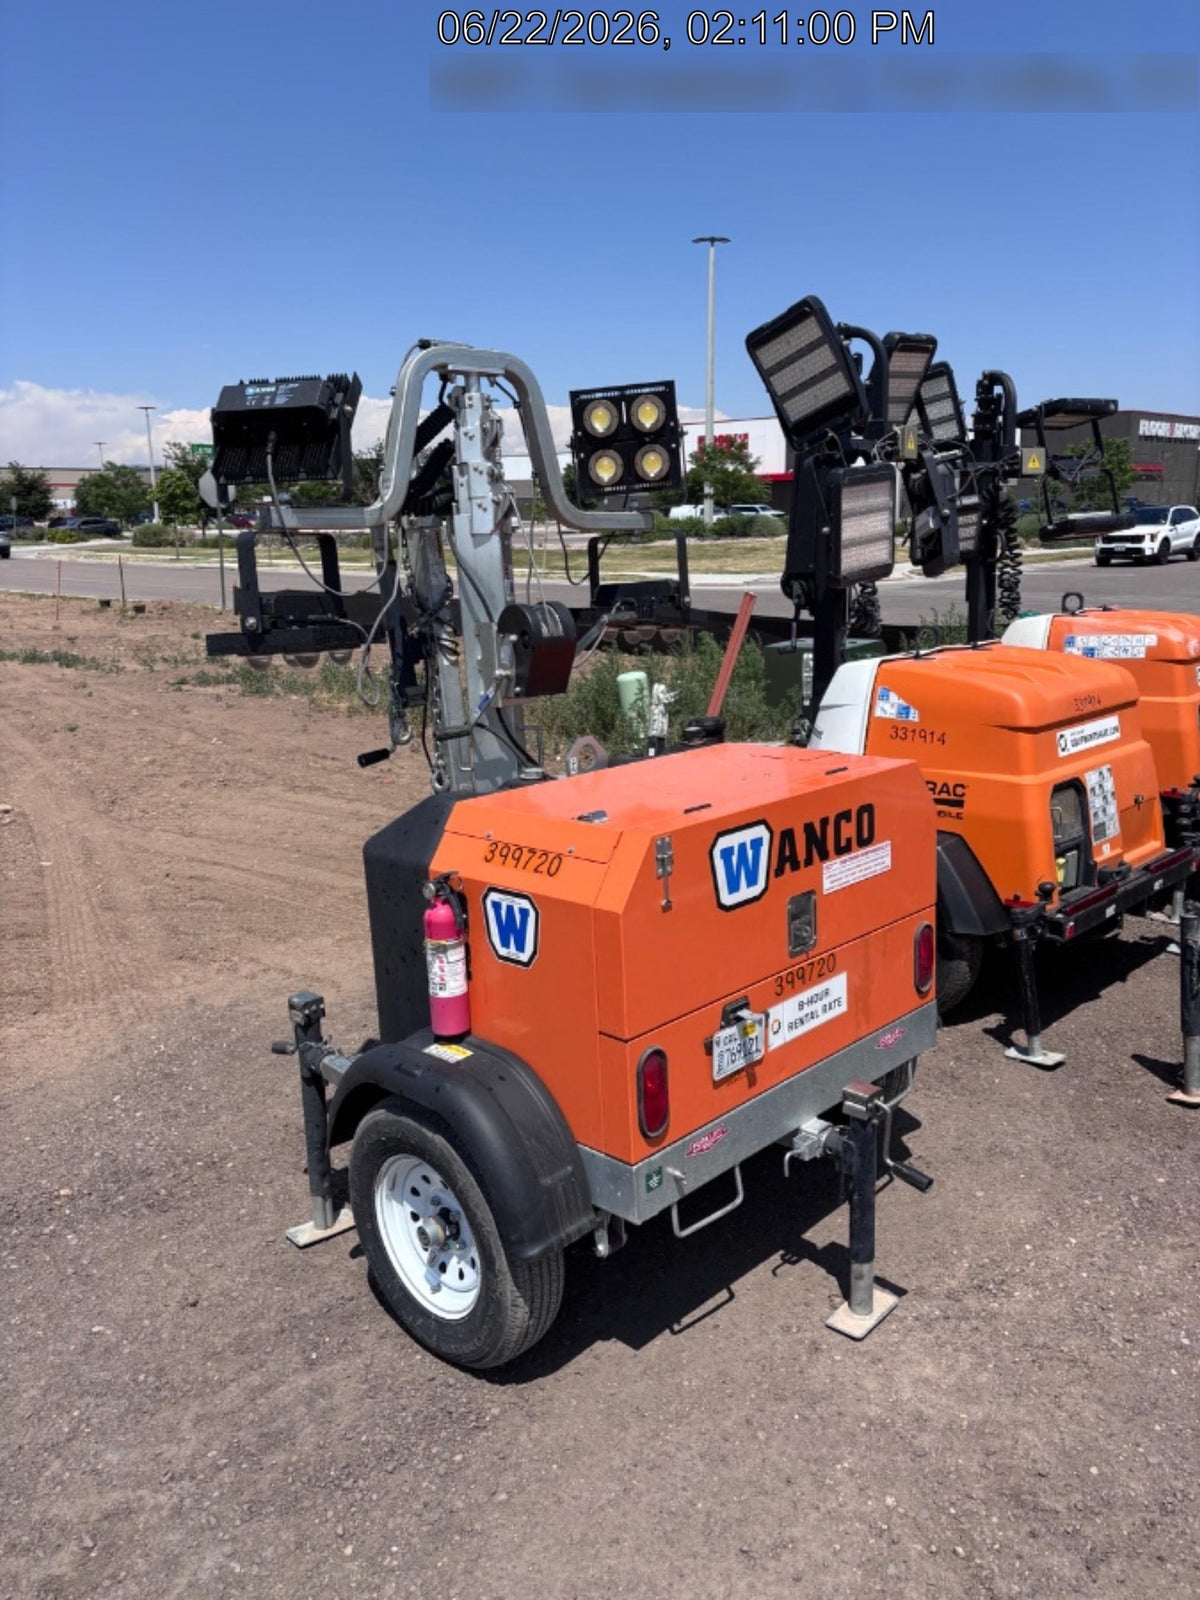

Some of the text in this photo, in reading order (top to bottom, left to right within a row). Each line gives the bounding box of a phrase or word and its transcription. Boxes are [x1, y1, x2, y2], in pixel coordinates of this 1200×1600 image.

[889, 724, 947, 746] 331914
[484, 841, 563, 878] 399720
[491, 900, 530, 954] W
[774, 952, 837, 997] 399720
[787, 996, 844, 1033] RENTAL RATE
[798, 987, 831, 1011] 8-HOUR
